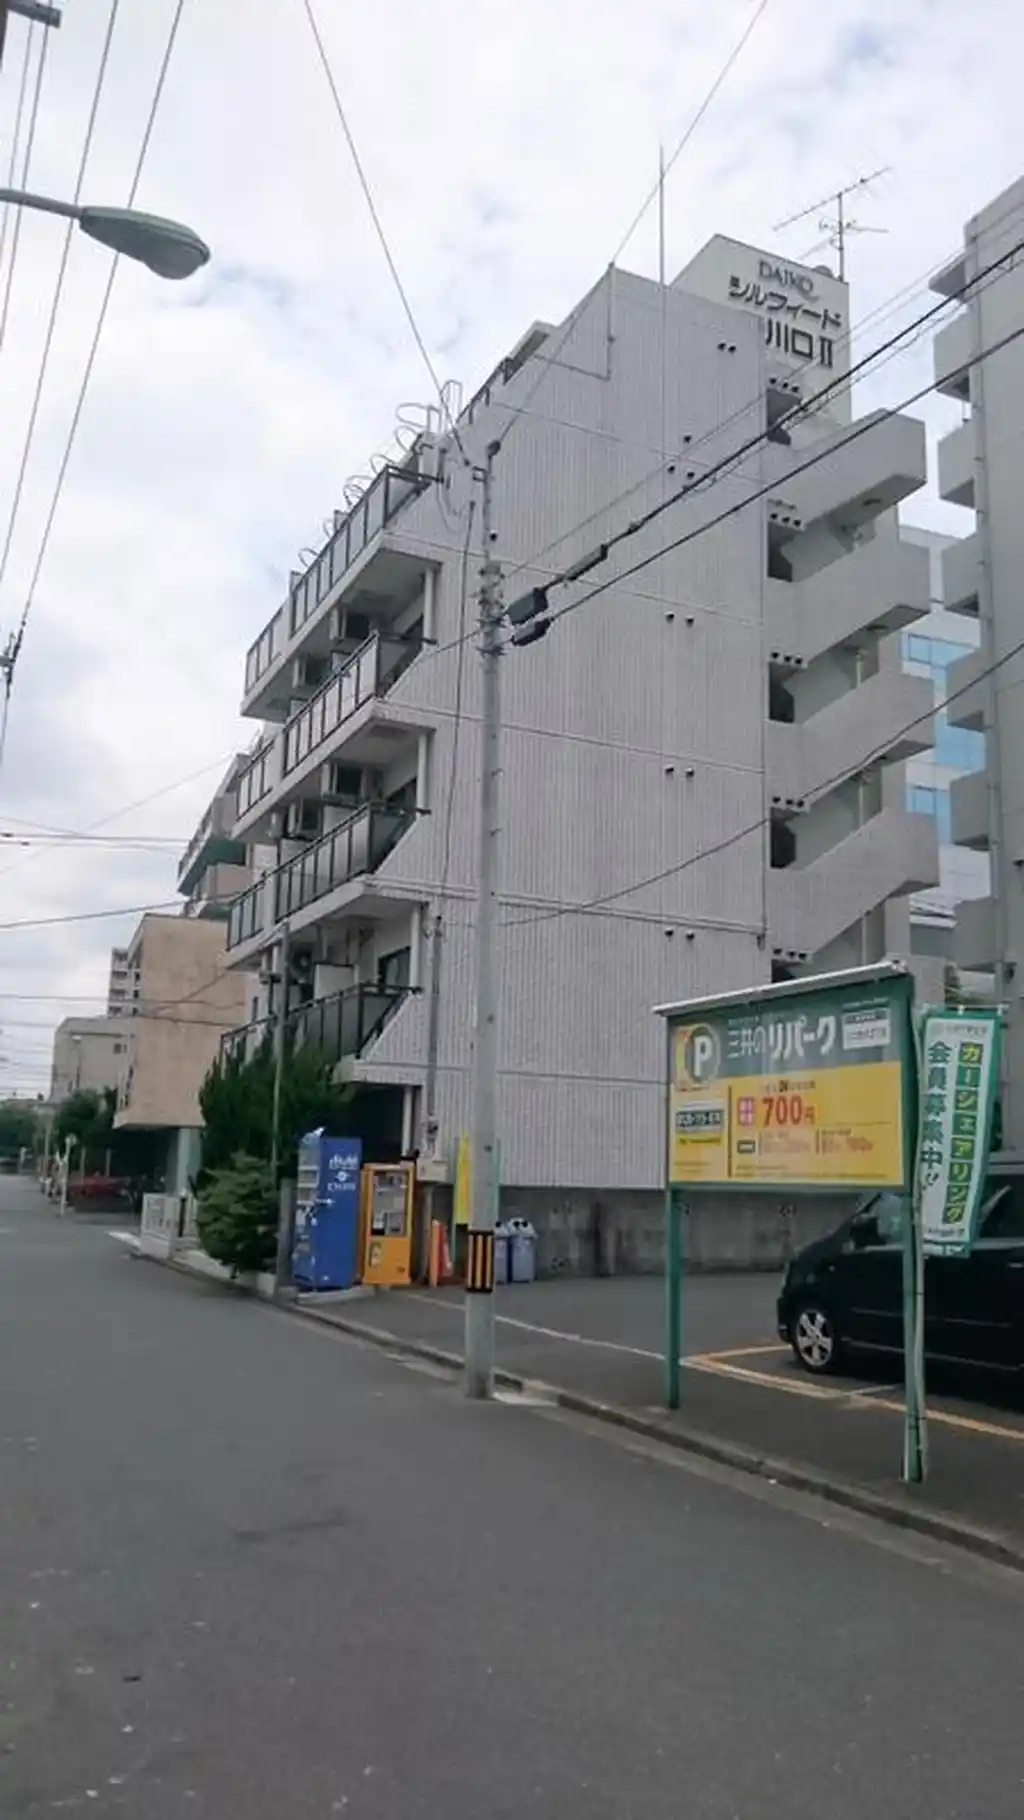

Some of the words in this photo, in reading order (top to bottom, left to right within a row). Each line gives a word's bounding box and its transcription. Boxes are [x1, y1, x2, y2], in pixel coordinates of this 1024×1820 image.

[729, 275, 841, 330] シルフィード
[728, 1016, 836, 1060] 三井のリパーク
[944, 1043, 982, 1224] カーシェアリング
